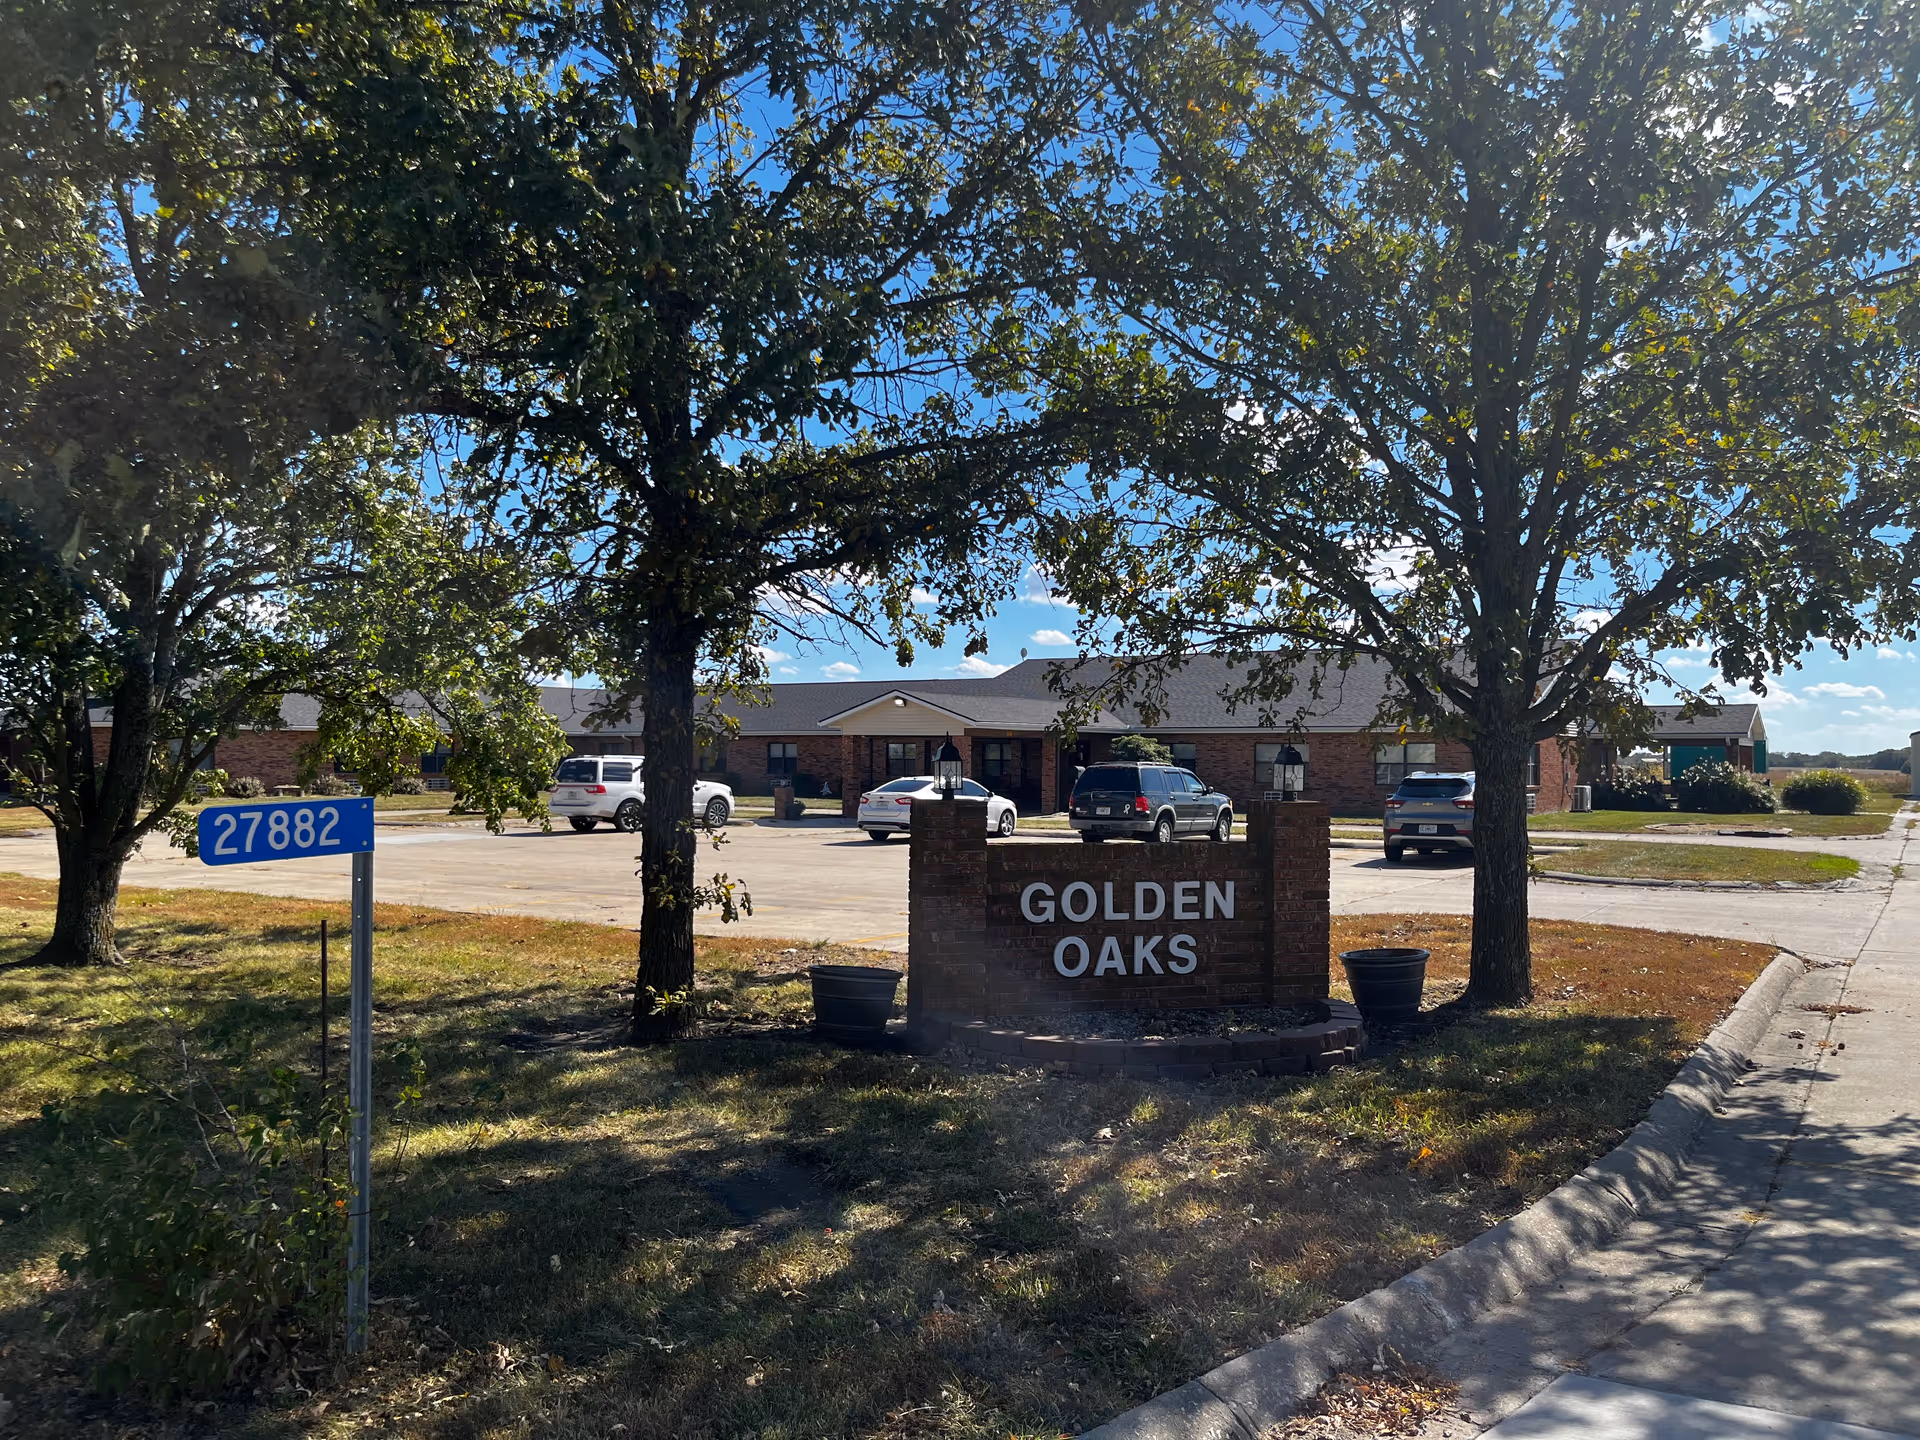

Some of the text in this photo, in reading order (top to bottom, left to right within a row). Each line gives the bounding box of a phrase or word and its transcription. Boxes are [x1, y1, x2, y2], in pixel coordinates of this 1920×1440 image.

[214, 806, 341, 856] 27882
[1020, 880, 1235, 924] GOLDEN
[1053, 933, 1198, 978] OAKS
